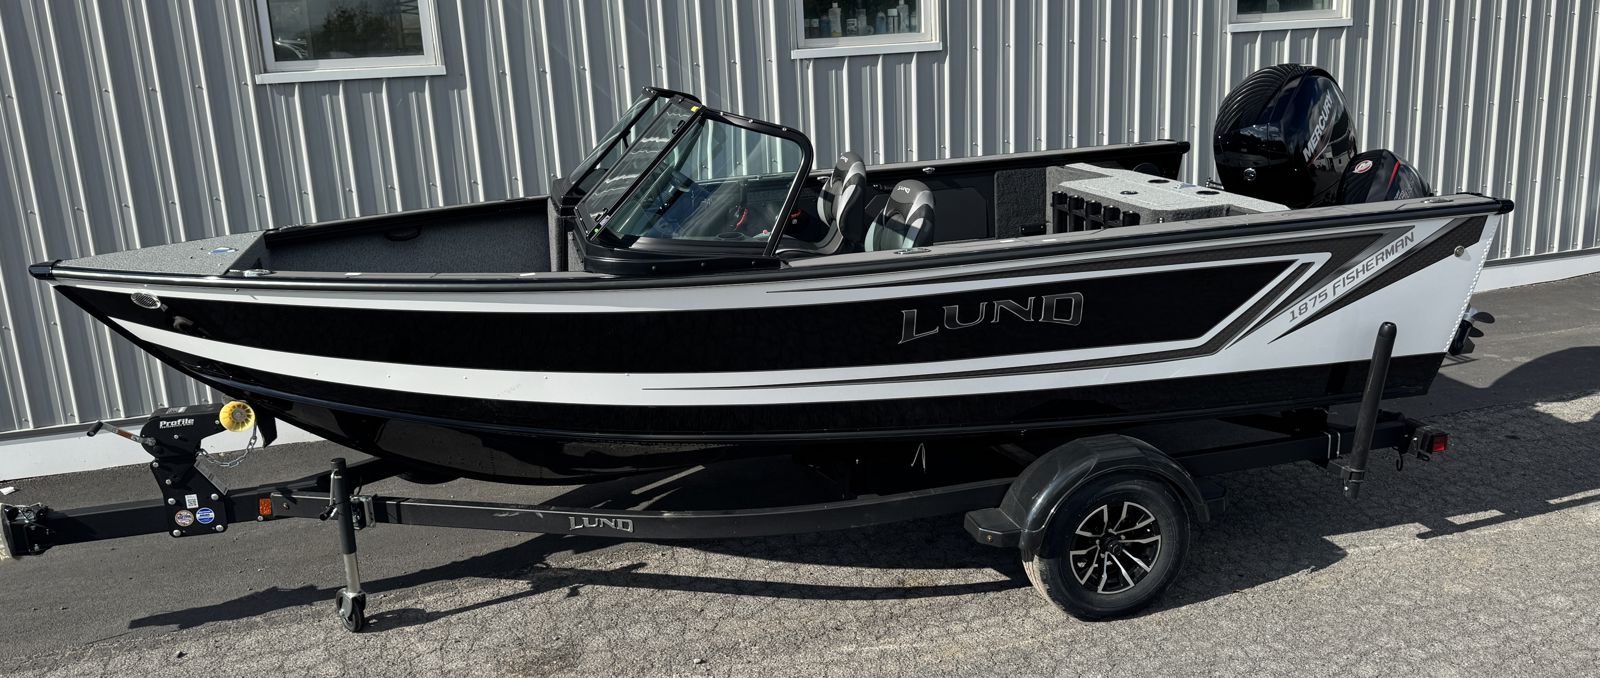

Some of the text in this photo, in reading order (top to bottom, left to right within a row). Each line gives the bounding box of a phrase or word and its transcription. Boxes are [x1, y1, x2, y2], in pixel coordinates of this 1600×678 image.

[1302, 90, 1334, 163] MERCURY
[1289, 231, 1415, 322] 1875 FISHERMAN
[898, 291, 1084, 344] LUND
[159, 418, 195, 428] Profile
[568, 516, 634, 533] LUND
